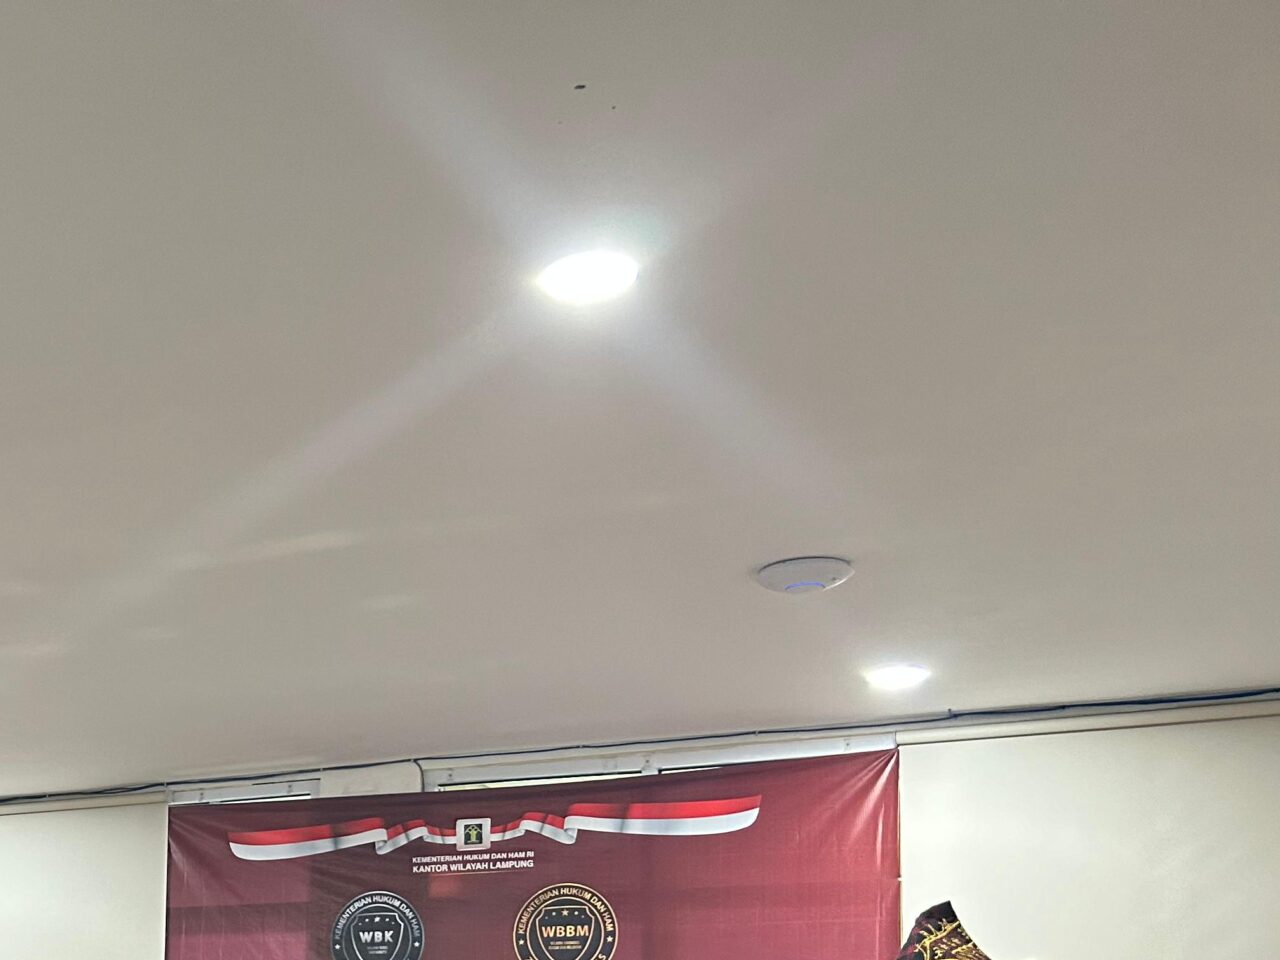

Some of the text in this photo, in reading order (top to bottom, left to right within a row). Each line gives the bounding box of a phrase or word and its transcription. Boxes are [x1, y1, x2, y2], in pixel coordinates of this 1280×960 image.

[412, 854, 462, 863] KEMENTERIAN
[463, 853, 490, 861] HUKUM
[491, 852, 507, 860] DAN
[508, 851, 525, 859] HAM
[412, 860, 534, 873] KANTOR WILAYAH LAMPUNG
[335, 895, 420, 939] KEMENTERIAN HUKUM DAN HAM
[518, 887, 614, 934] KEMENTERIAN HUKUM DAN HAM
[359, 930, 394, 943] WBK
[541, 925, 589, 938] WBBM
